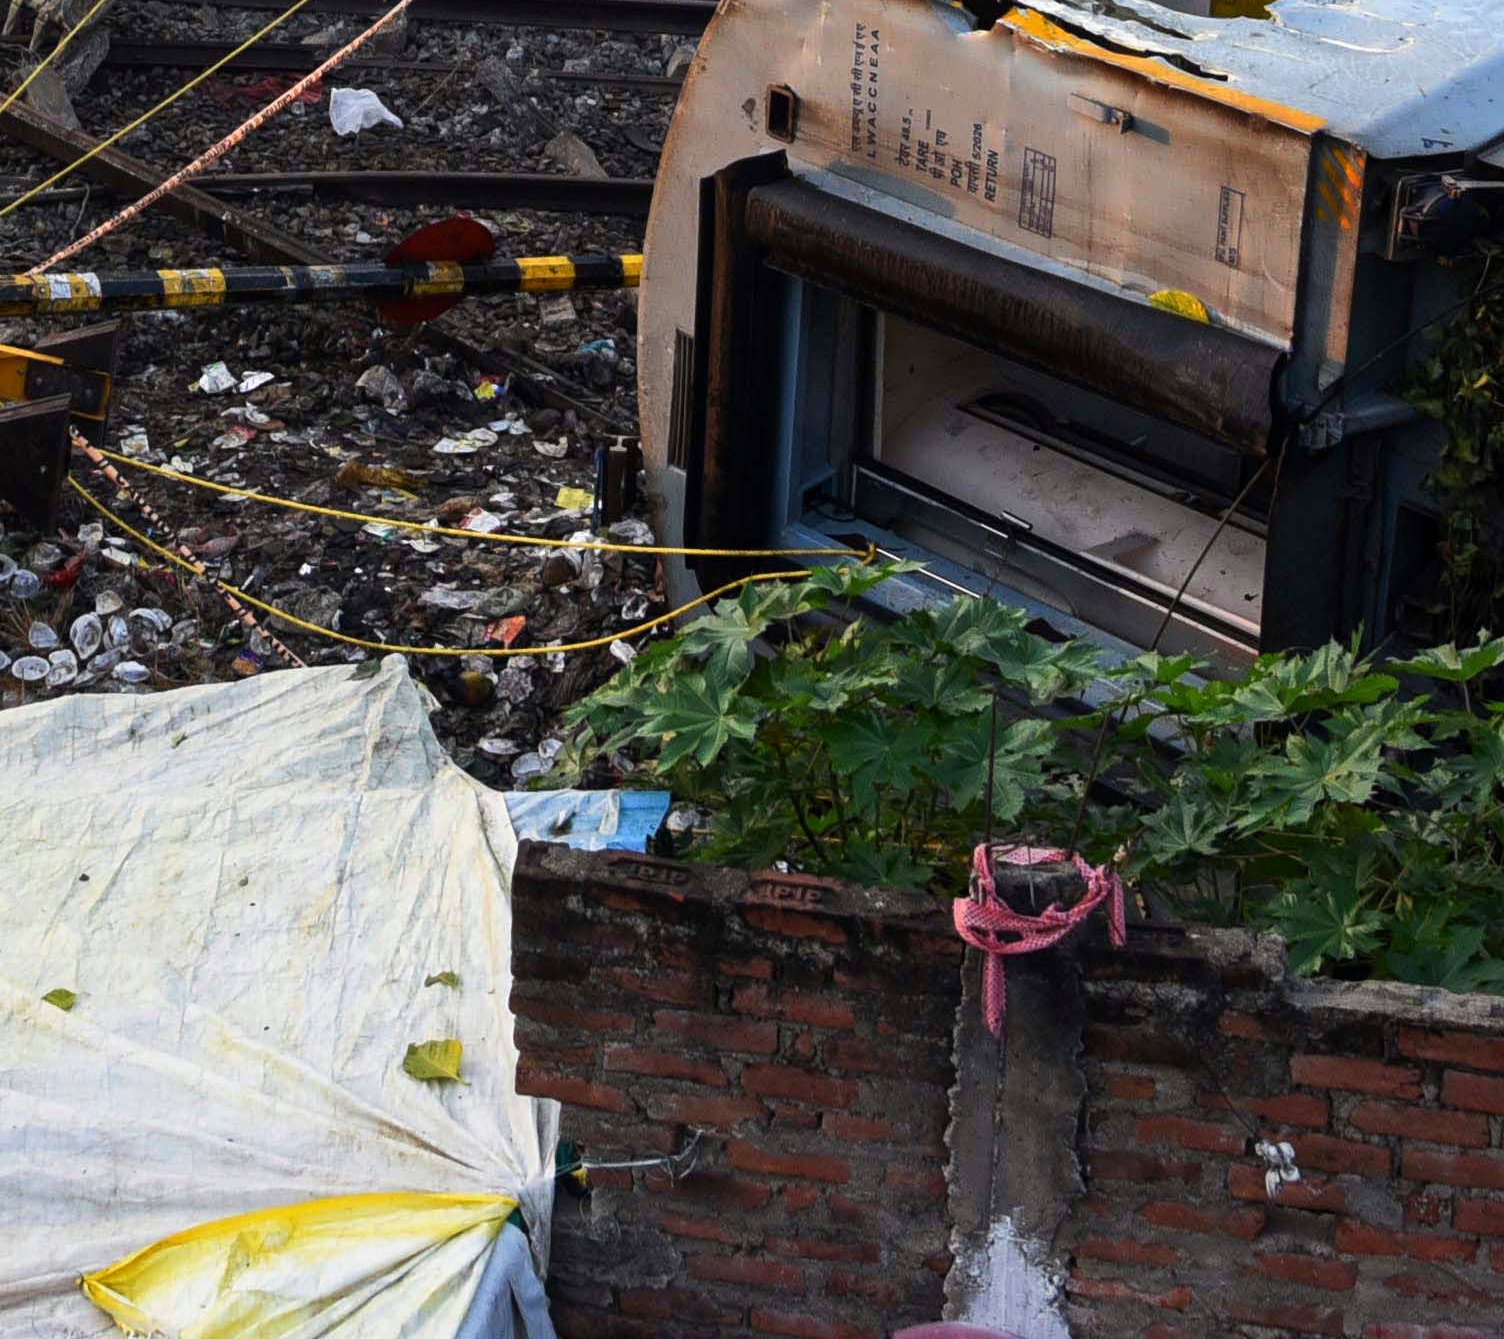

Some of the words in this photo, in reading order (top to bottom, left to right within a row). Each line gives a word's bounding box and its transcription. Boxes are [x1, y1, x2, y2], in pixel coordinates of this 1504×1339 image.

[915, 139, 931, 172] TARE
[950, 159, 964, 188] POH
[965, 161, 980, 194] वापसी
[984, 149, 1000, 202] RETURN
